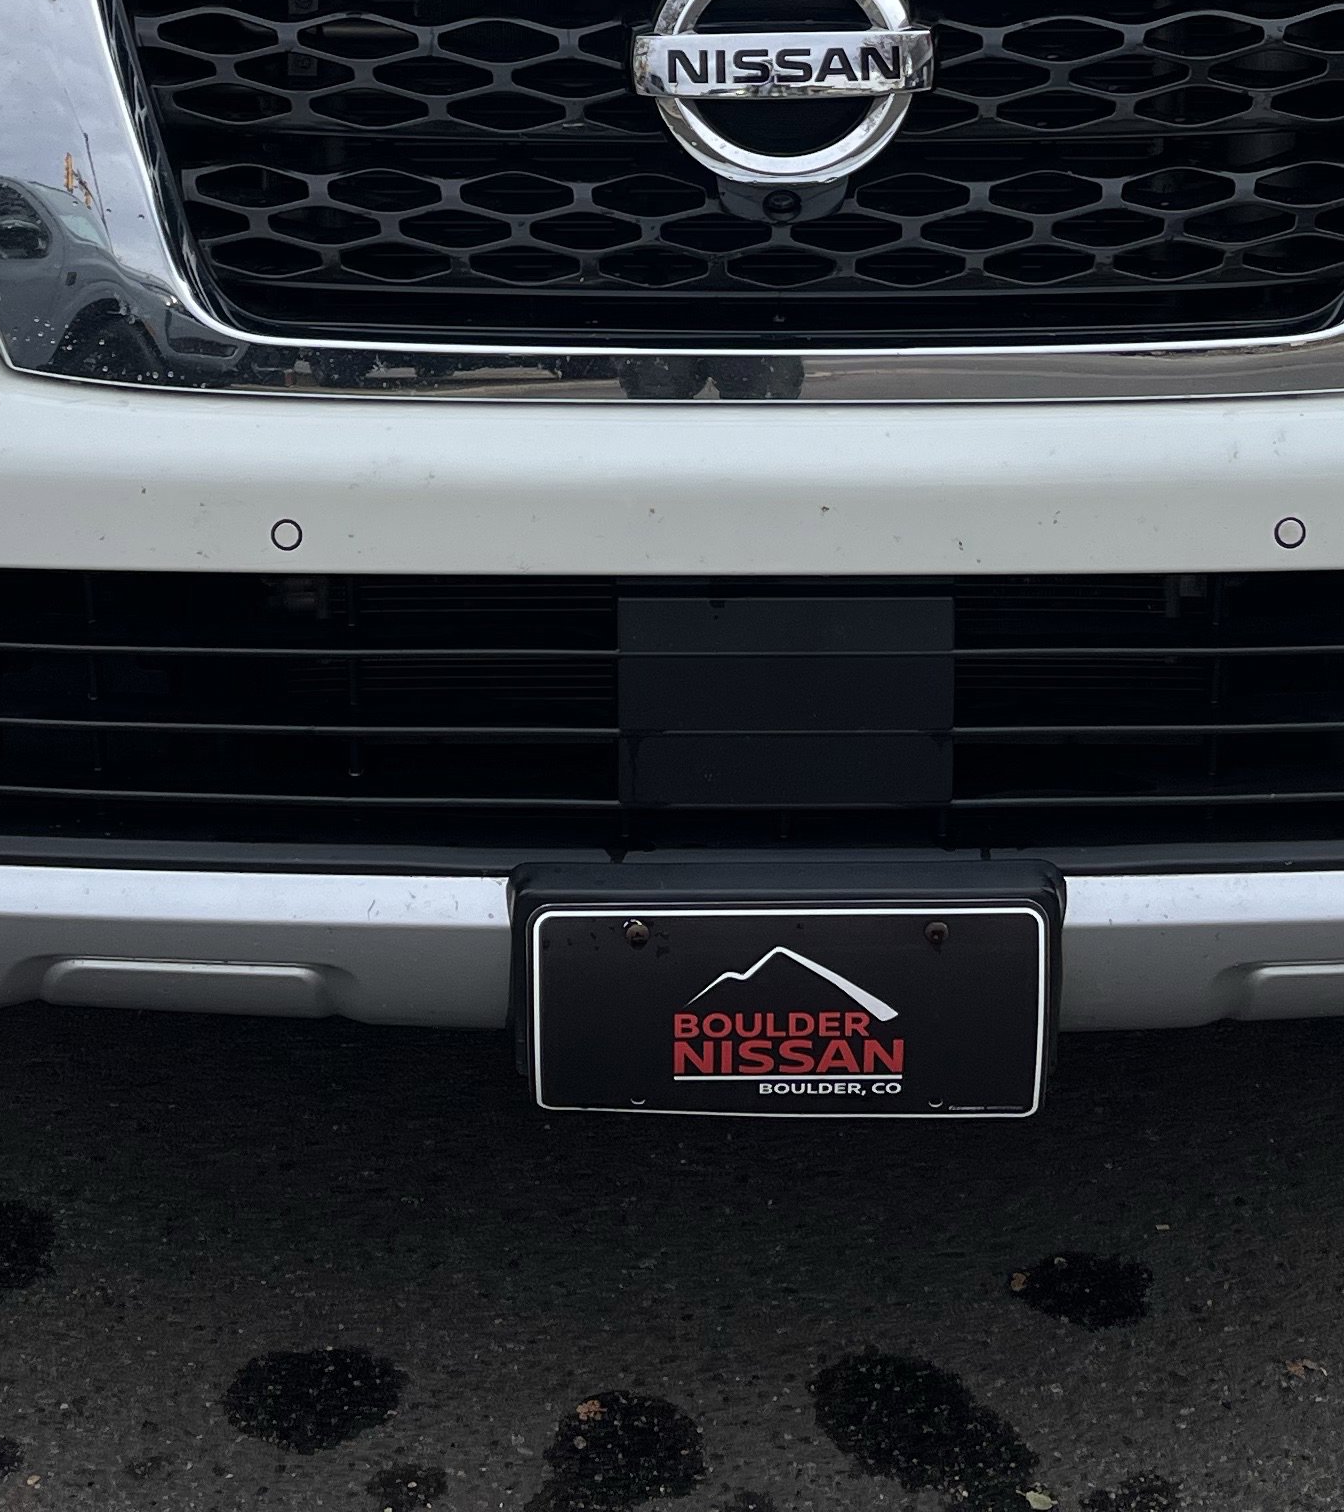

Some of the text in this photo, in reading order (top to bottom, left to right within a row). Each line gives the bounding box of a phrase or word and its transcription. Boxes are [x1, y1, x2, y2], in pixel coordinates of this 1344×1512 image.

[667, 45, 902, 84] NISSAN
[674, 1012, 870, 1038] BOULDER
[674, 1039, 904, 1074] NISSAN
[759, 1082, 902, 1096] BOULDER, CO
